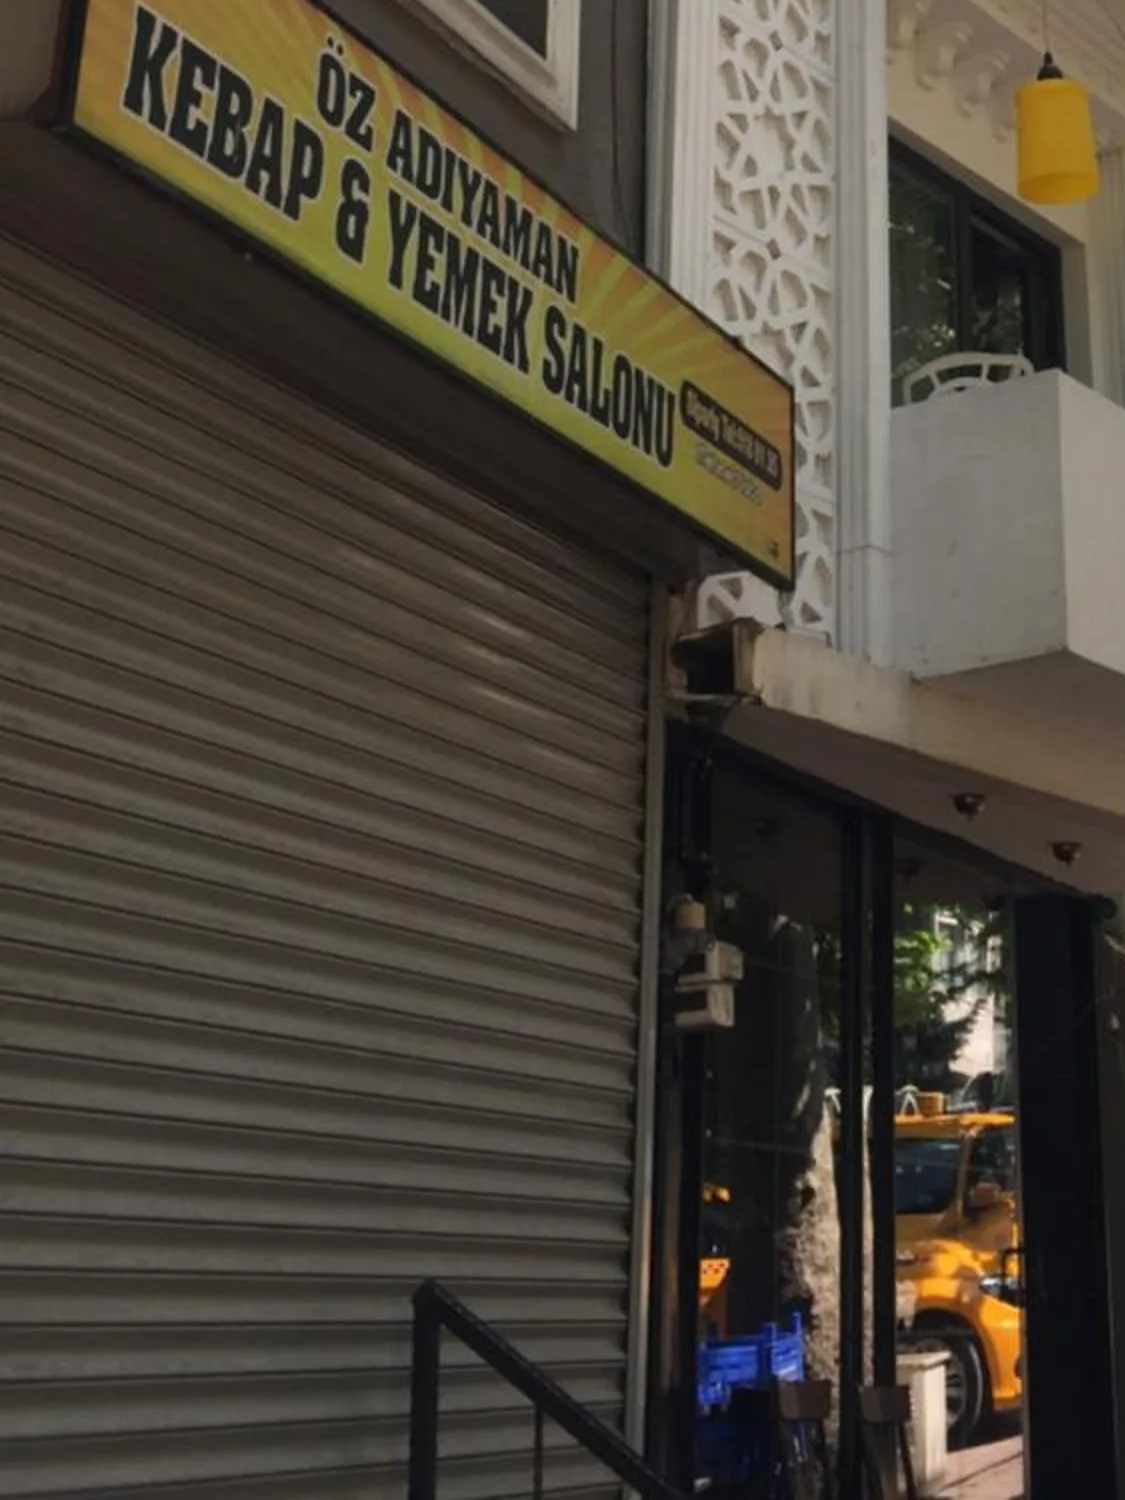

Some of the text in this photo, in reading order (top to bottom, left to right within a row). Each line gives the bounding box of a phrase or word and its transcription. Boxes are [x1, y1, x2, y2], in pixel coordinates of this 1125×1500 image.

[122, 5, 325, 221] KEBAP
[335, 159, 371, 263] &
[387, 193, 531, 374] YEMEK
[542, 310, 677, 467] SALONU
[316, 36, 580, 303] ÖZ ADIYAMAN
